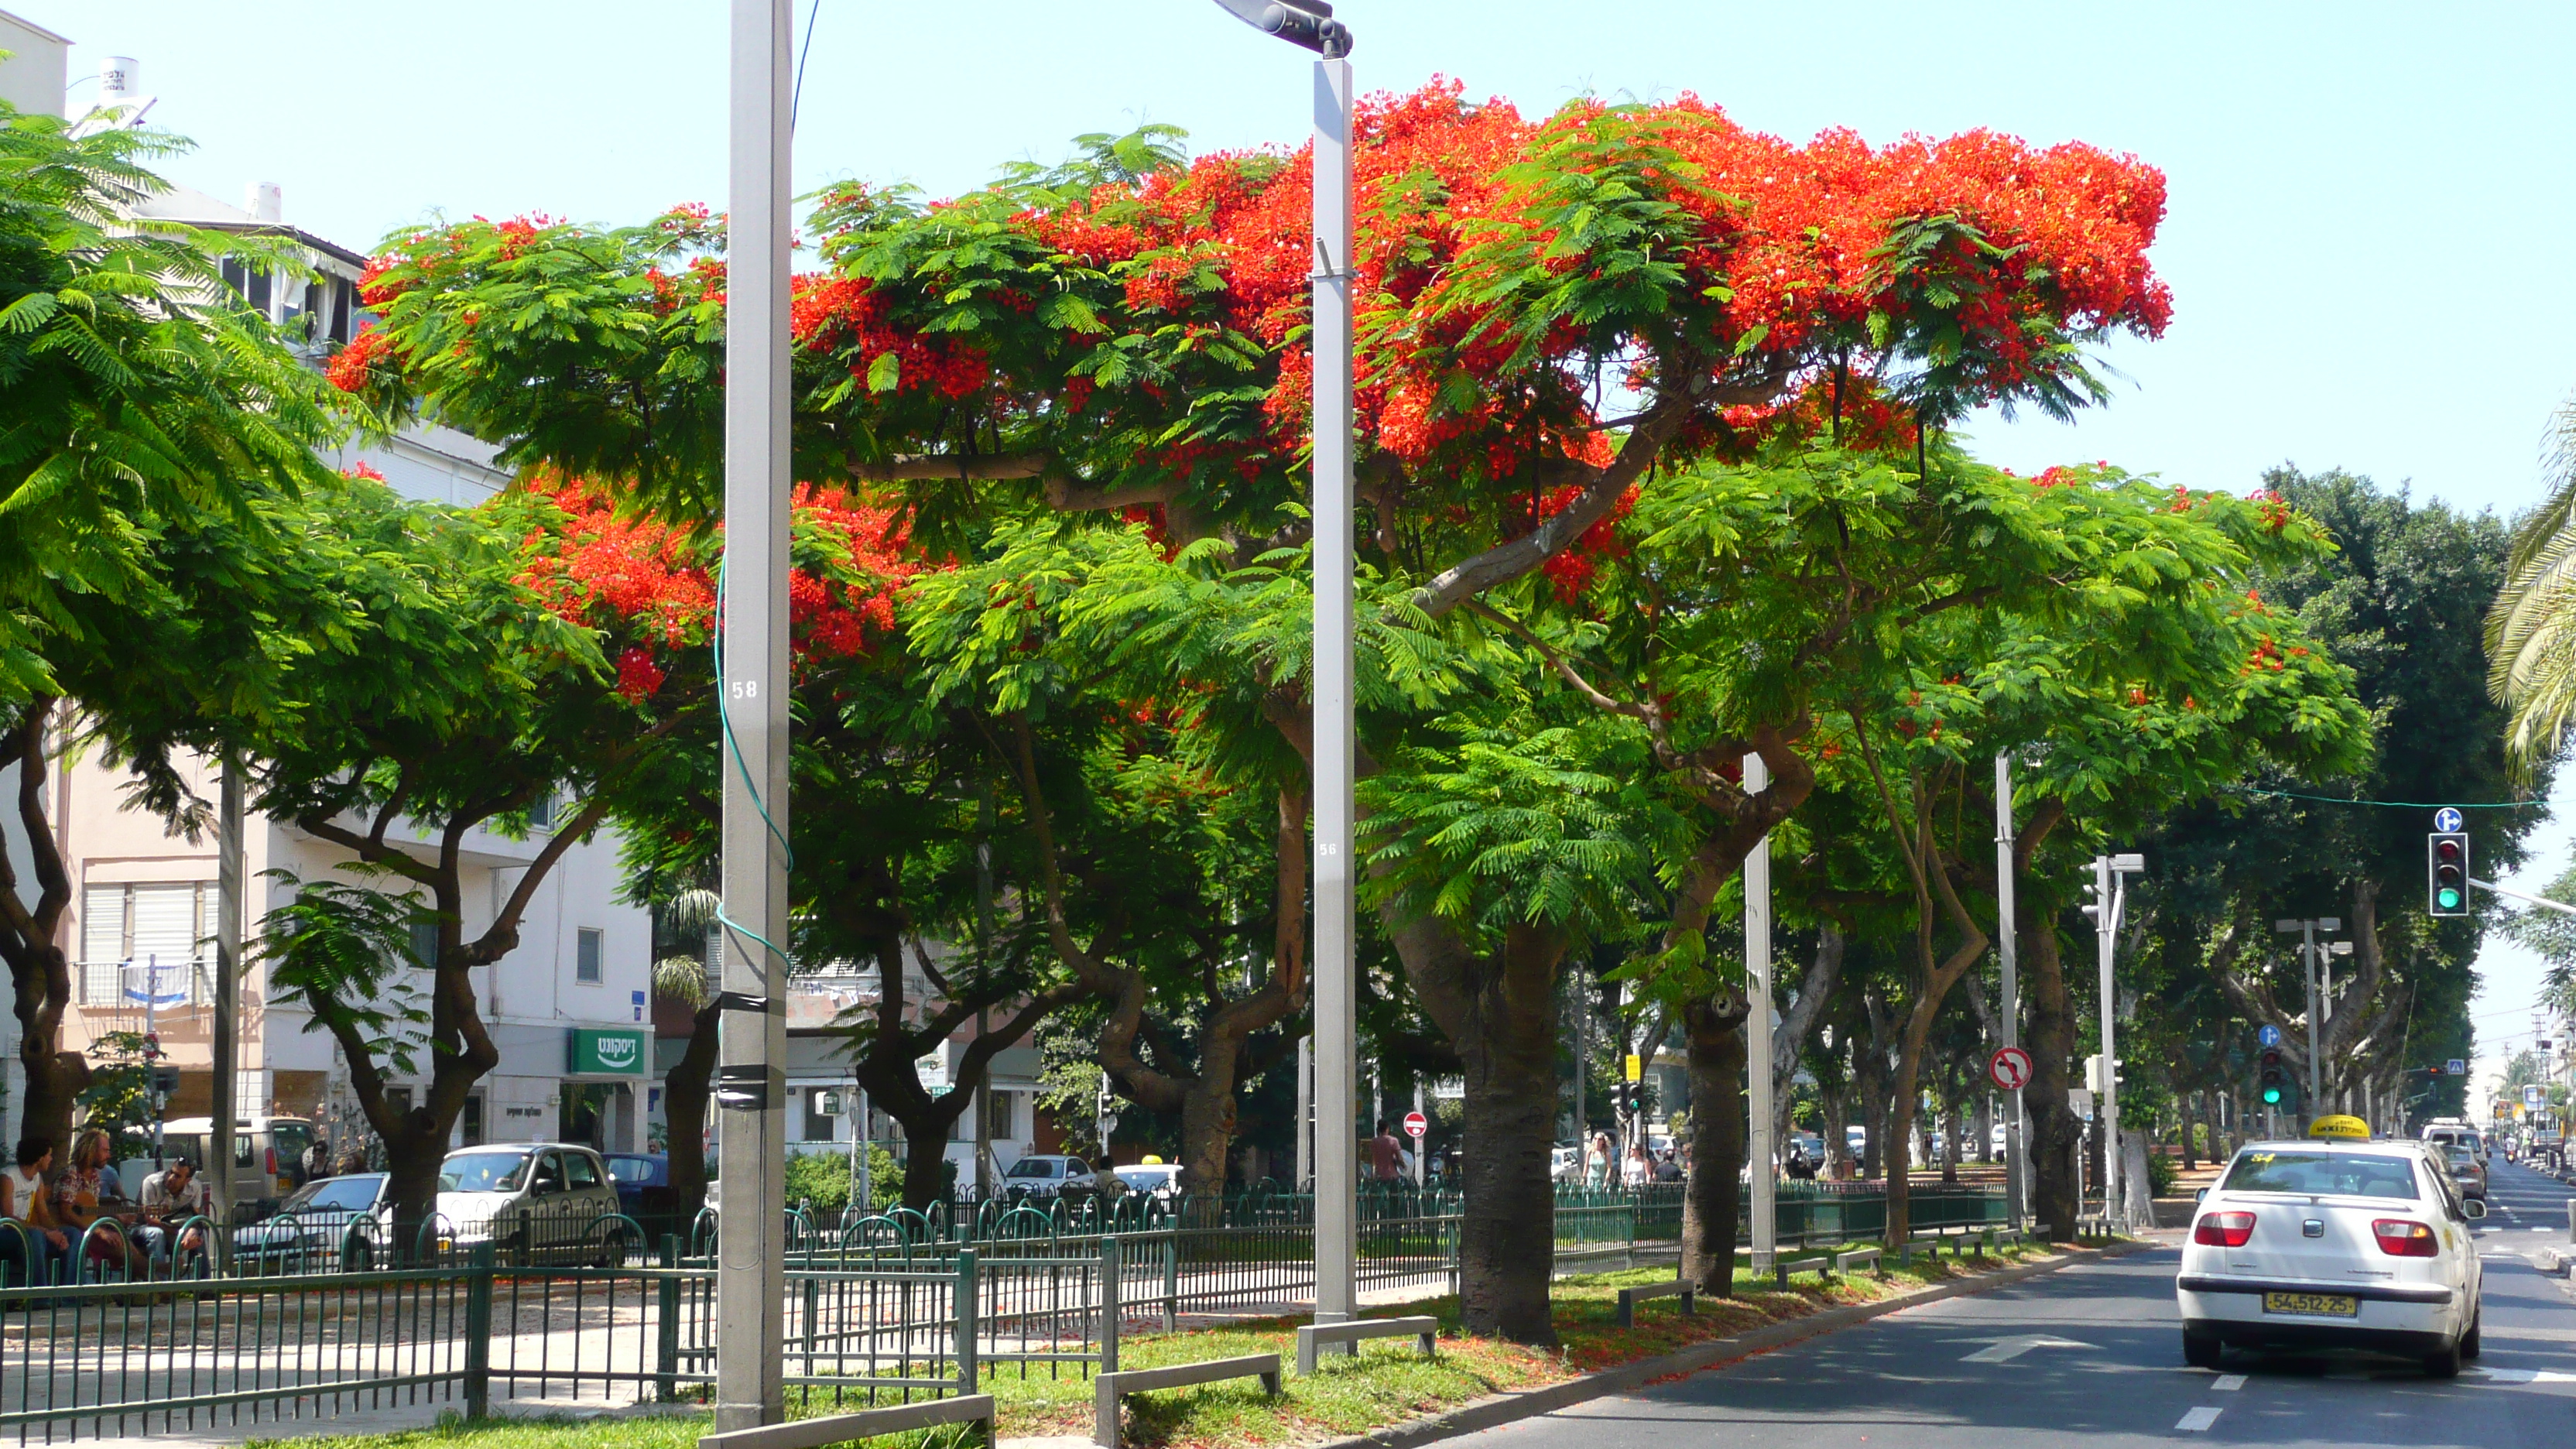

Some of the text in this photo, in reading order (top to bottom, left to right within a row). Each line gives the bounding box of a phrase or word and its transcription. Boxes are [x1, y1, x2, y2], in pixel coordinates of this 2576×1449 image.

[731, 680, 757, 700] 58
[1319, 843, 1337, 856] 56
[598, 1037, 636, 1058] דיסקונט
